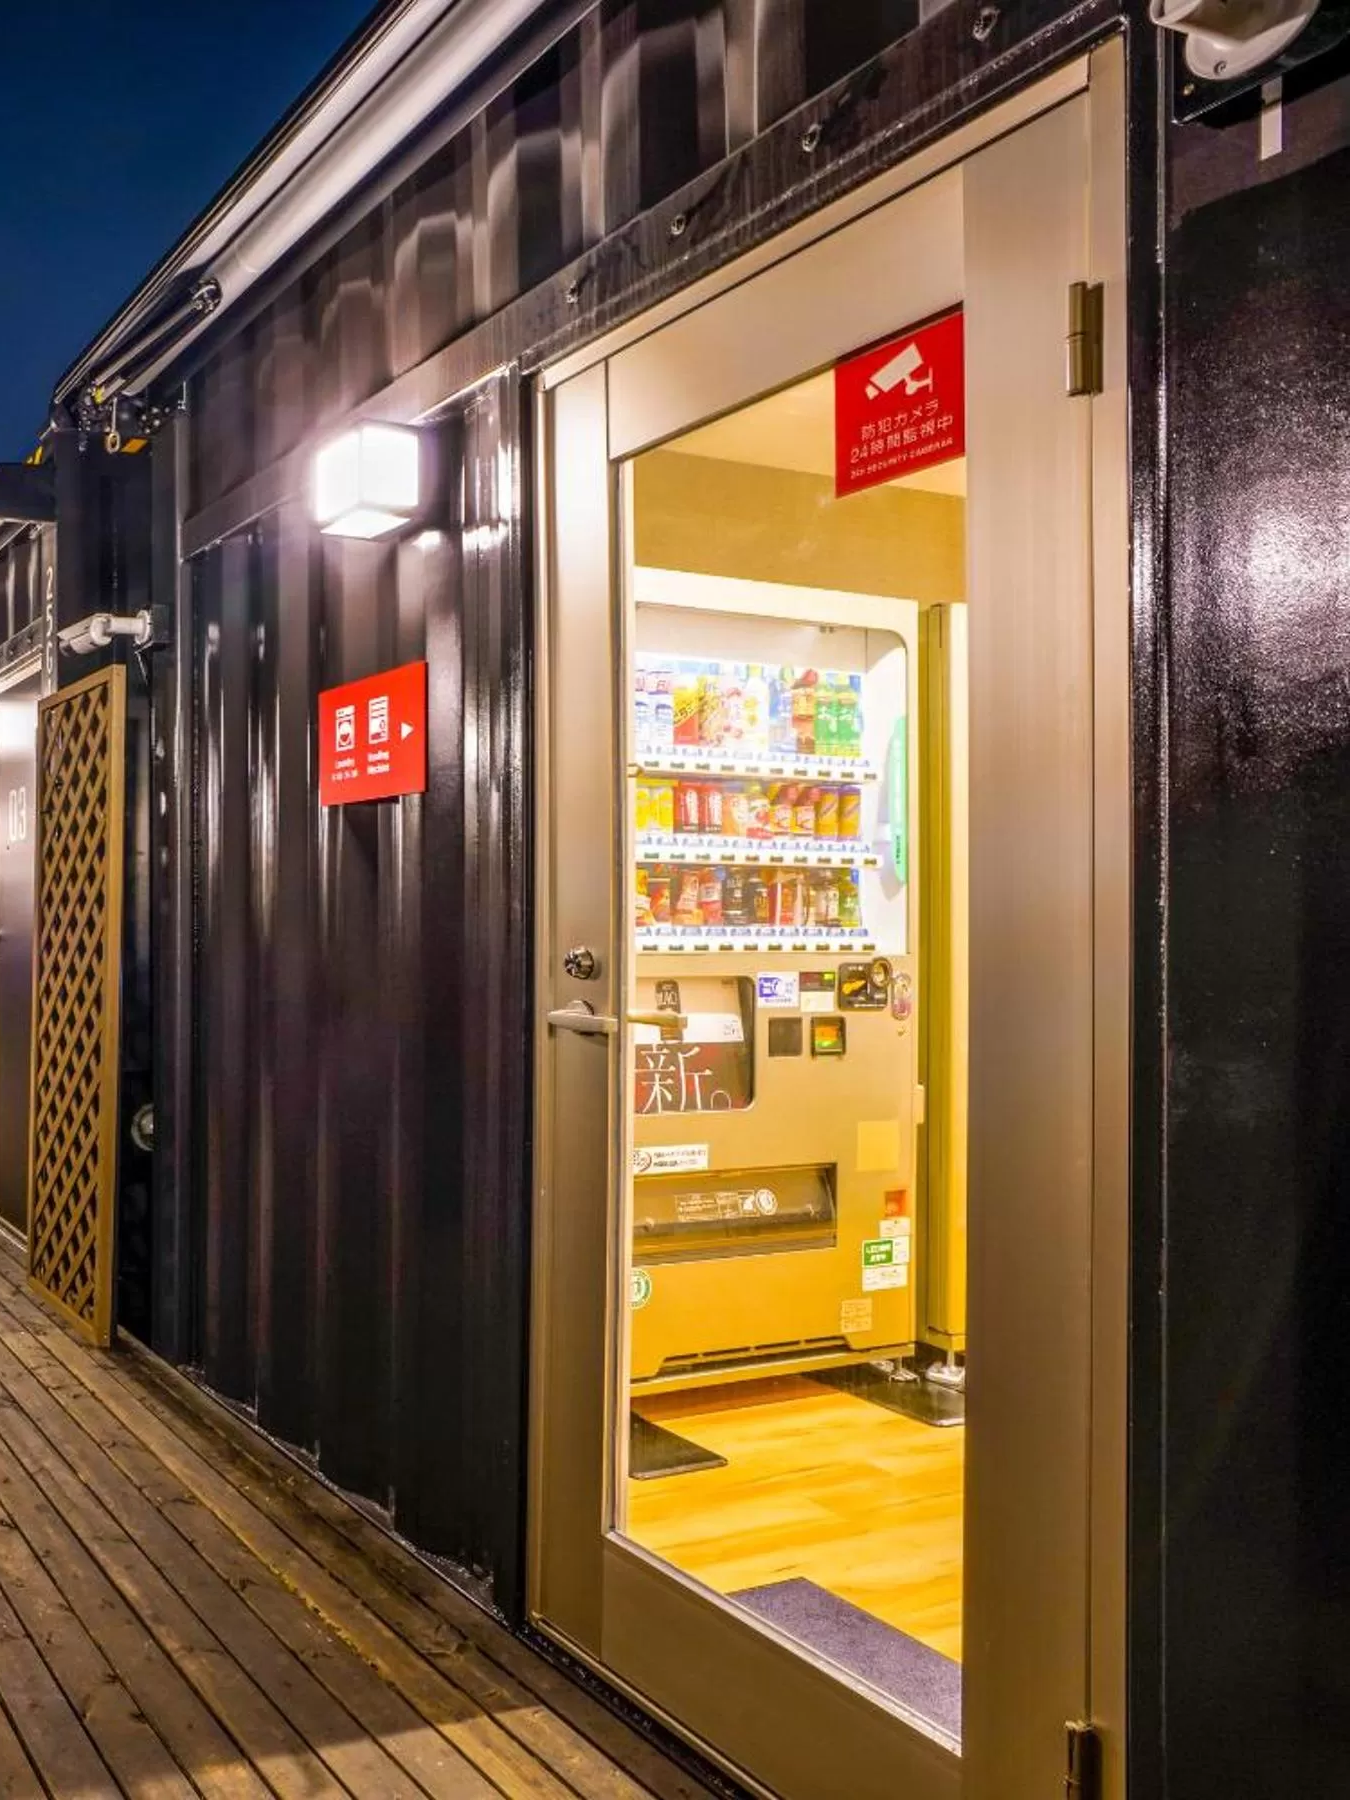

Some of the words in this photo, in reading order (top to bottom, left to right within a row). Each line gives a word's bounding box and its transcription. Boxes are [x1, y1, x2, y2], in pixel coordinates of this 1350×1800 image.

[850, 414, 954, 464] 24時間監視中
[861, 399, 939, 441] 防犯カメラ
